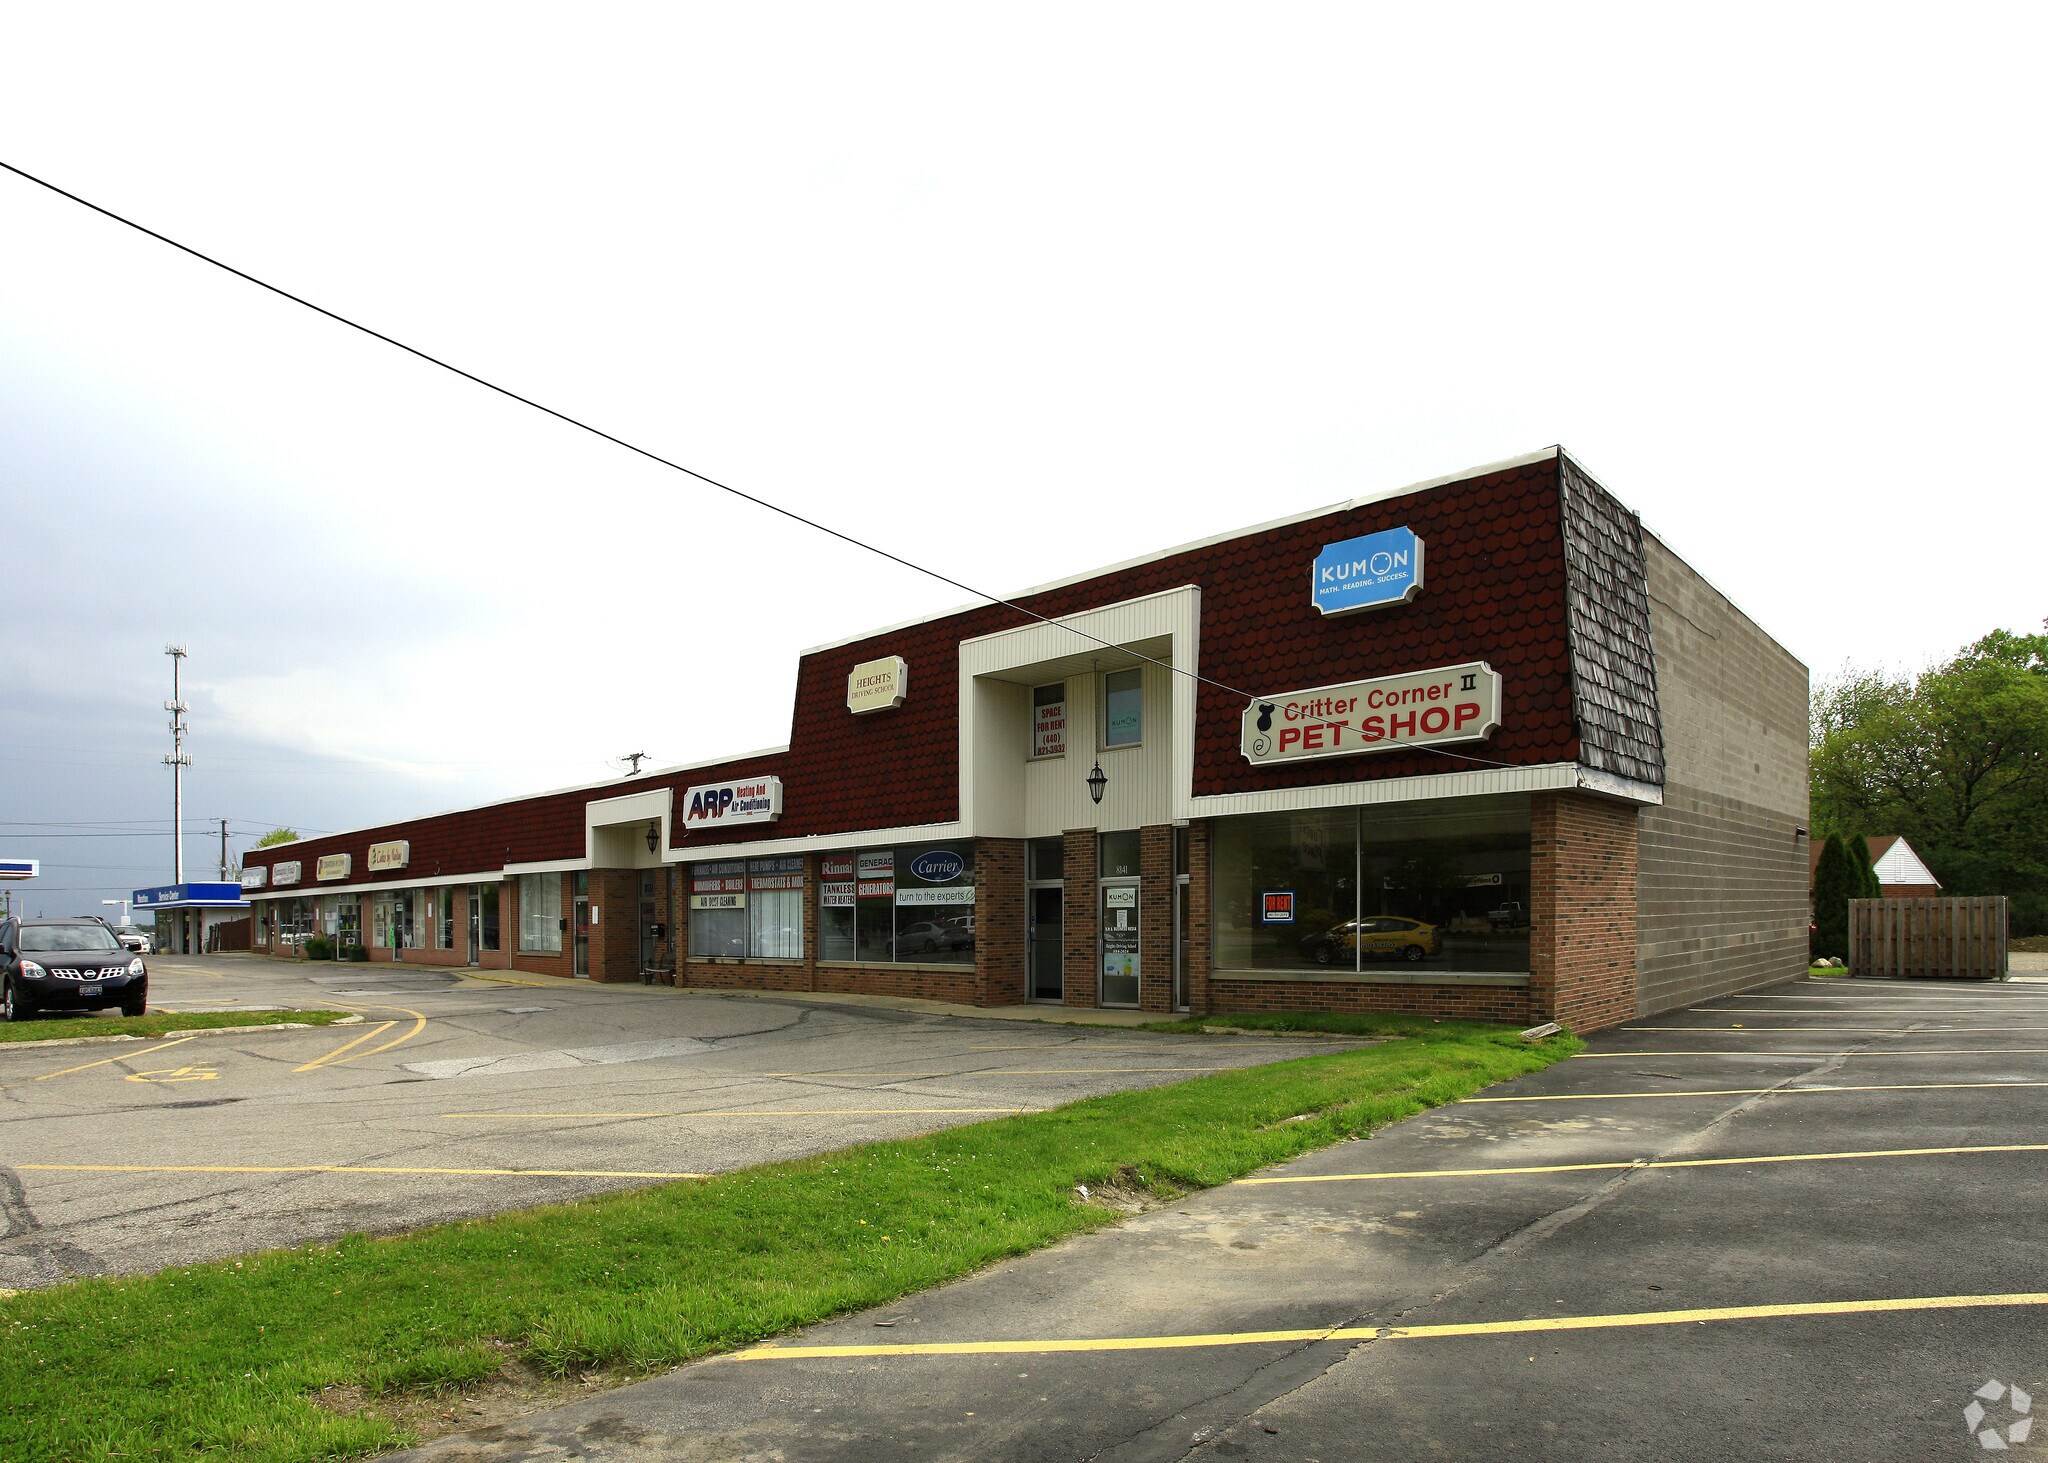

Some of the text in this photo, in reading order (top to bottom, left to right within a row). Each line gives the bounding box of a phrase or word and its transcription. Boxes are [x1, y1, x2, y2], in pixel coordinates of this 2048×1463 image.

[1321, 549, 1408, 583] KUMON
[1319, 571, 1409, 595] MATH. READING. SUCCESS.
[856, 671, 892, 689] HEIGHTS
[851, 683, 895, 699] DRIVING SCHOOL
[1284, 696, 1358, 722] Critter
[1367, 681, 1452, 710] Corner
[1041, 706, 1062, 719] SPACE
[1037, 719, 1065, 733] FOR RENT
[1111, 716, 1137, 727] KUMON
[1278, 702, 1481, 753] PET SHOP
[1042, 732, 1060, 745] (440)
[736, 783, 766, 798] Heating And
[687, 787, 734, 821] ARP
[731, 797, 771, 812] Air Conditioning
[821, 860, 853, 875] Rinnai
[859, 857, 893, 868] GENERAC
[918, 859, 958, 874] Carrier
[751, 876, 786, 889] THERMOSTATS
[823, 883, 855, 894] TANKLESS
[858, 882, 895, 896] GENERATORS
[700, 896, 708, 907] AIR
[823, 895, 837, 905] WATER
[899, 890, 965, 903] turn to the experts
[1108, 892, 1134, 901] KUMON
[1265, 895, 1291, 911] FOR RENT
